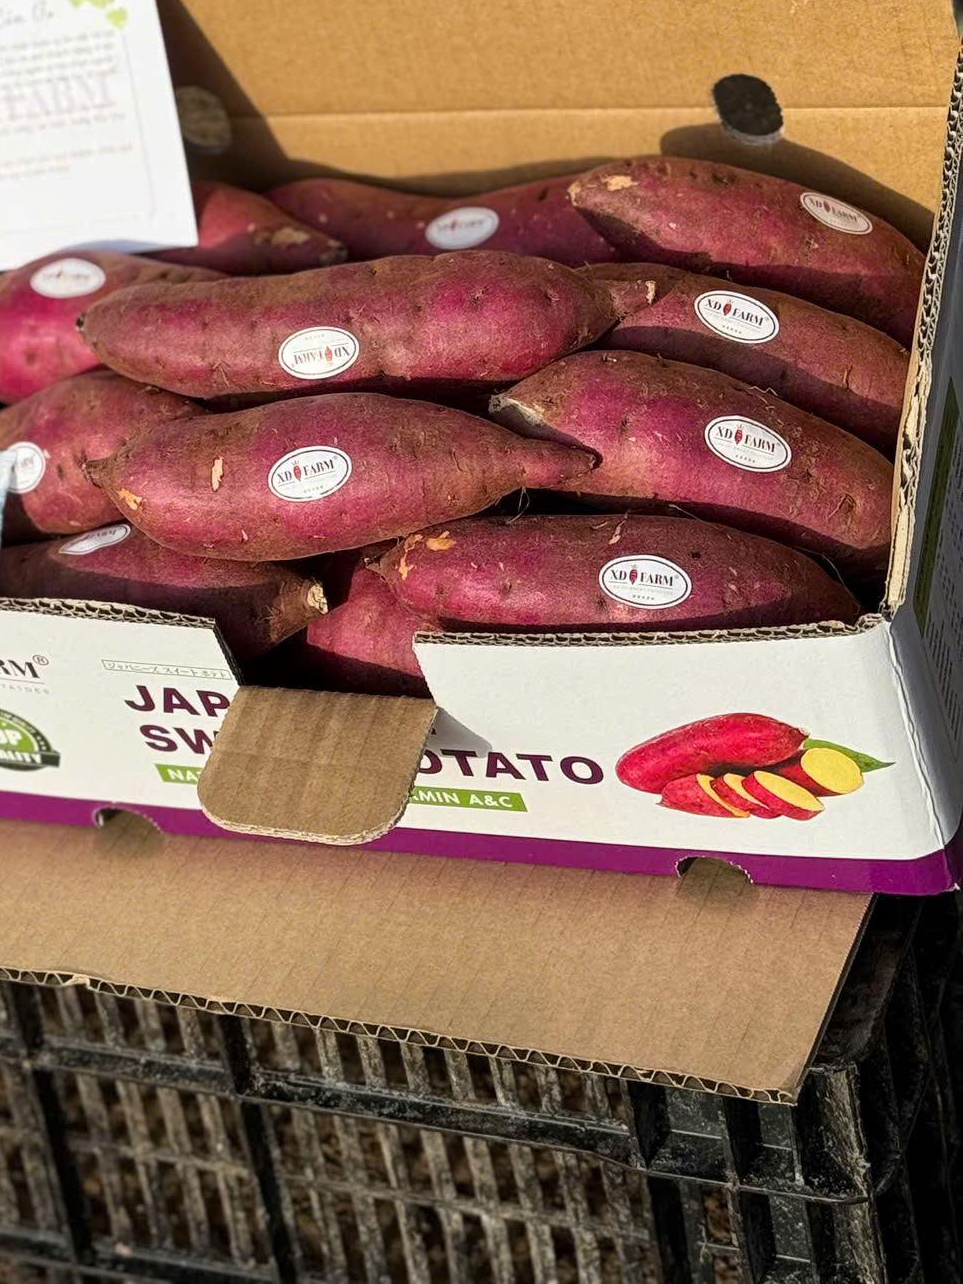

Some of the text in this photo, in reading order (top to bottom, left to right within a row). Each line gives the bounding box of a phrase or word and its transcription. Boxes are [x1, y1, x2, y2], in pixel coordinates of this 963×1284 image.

[732, 308, 764, 326] FARM
[293, 350, 323, 365] FARM
[744, 434, 776, 453] FARM
[303, 459, 335, 477] FARM
[610, 569, 673, 587] XD FARM
[417, 748, 604, 784] OTATO
[469, 795, 513, 808] A&C
